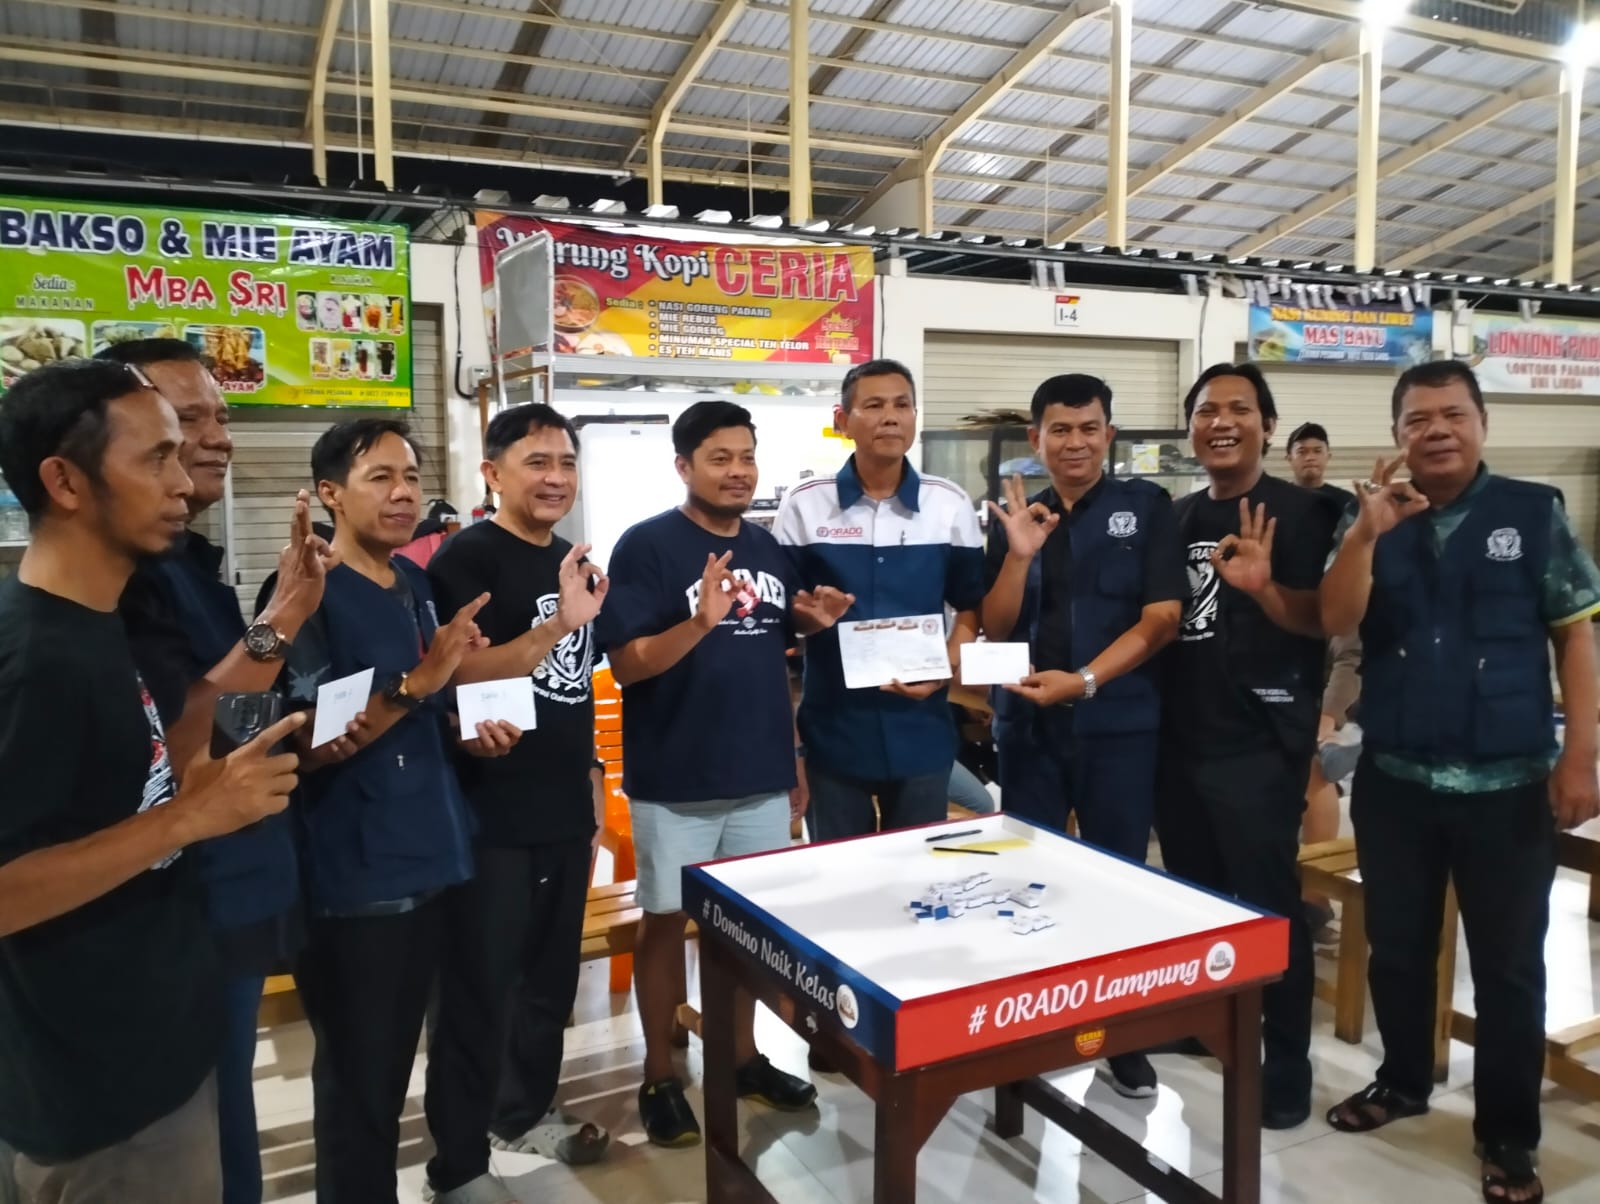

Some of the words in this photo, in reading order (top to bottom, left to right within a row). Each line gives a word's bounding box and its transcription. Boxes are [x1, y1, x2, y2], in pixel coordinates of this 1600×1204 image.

[0, 208, 145, 254] BAKSO
[160, 219, 191, 256] &
[203, 222, 278, 262] MIE
[289, 228, 395, 269] AYAM
[497, 227, 630, 279] rung
[634, 243, 710, 285] Kopi
[714, 247, 858, 301] CERIA
[16, 295, 95, 310] MAKANAN
[659, 301, 684, 312] NASI
[686, 303, 729, 315] GORENG
[731, 306, 771, 317] PADANG
[659, 312, 680, 322] MIE
[682, 314, 717, 324] REBUS
[659, 323, 680, 333] MIE
[683, 325, 725, 336] GORENG
[1303, 325, 1340, 346] MAS
[659, 333, 711, 345] MINUMAN
[714, 338, 756, 348] SPECIAL
[1487, 331, 1563, 357] LONTONG
[659, 345, 673, 354] ES
[698, 347, 733, 357] MANIS
[702, 898, 711, 919] #
[713, 904, 758, 954] Domino
[761, 937, 793, 980] Naik
[795, 961, 836, 1012] Kelas
[968, 1004, 988, 1035] #
[994, 979, 1088, 1028] ORADO
[1093, 958, 1201, 1004] Lampung
